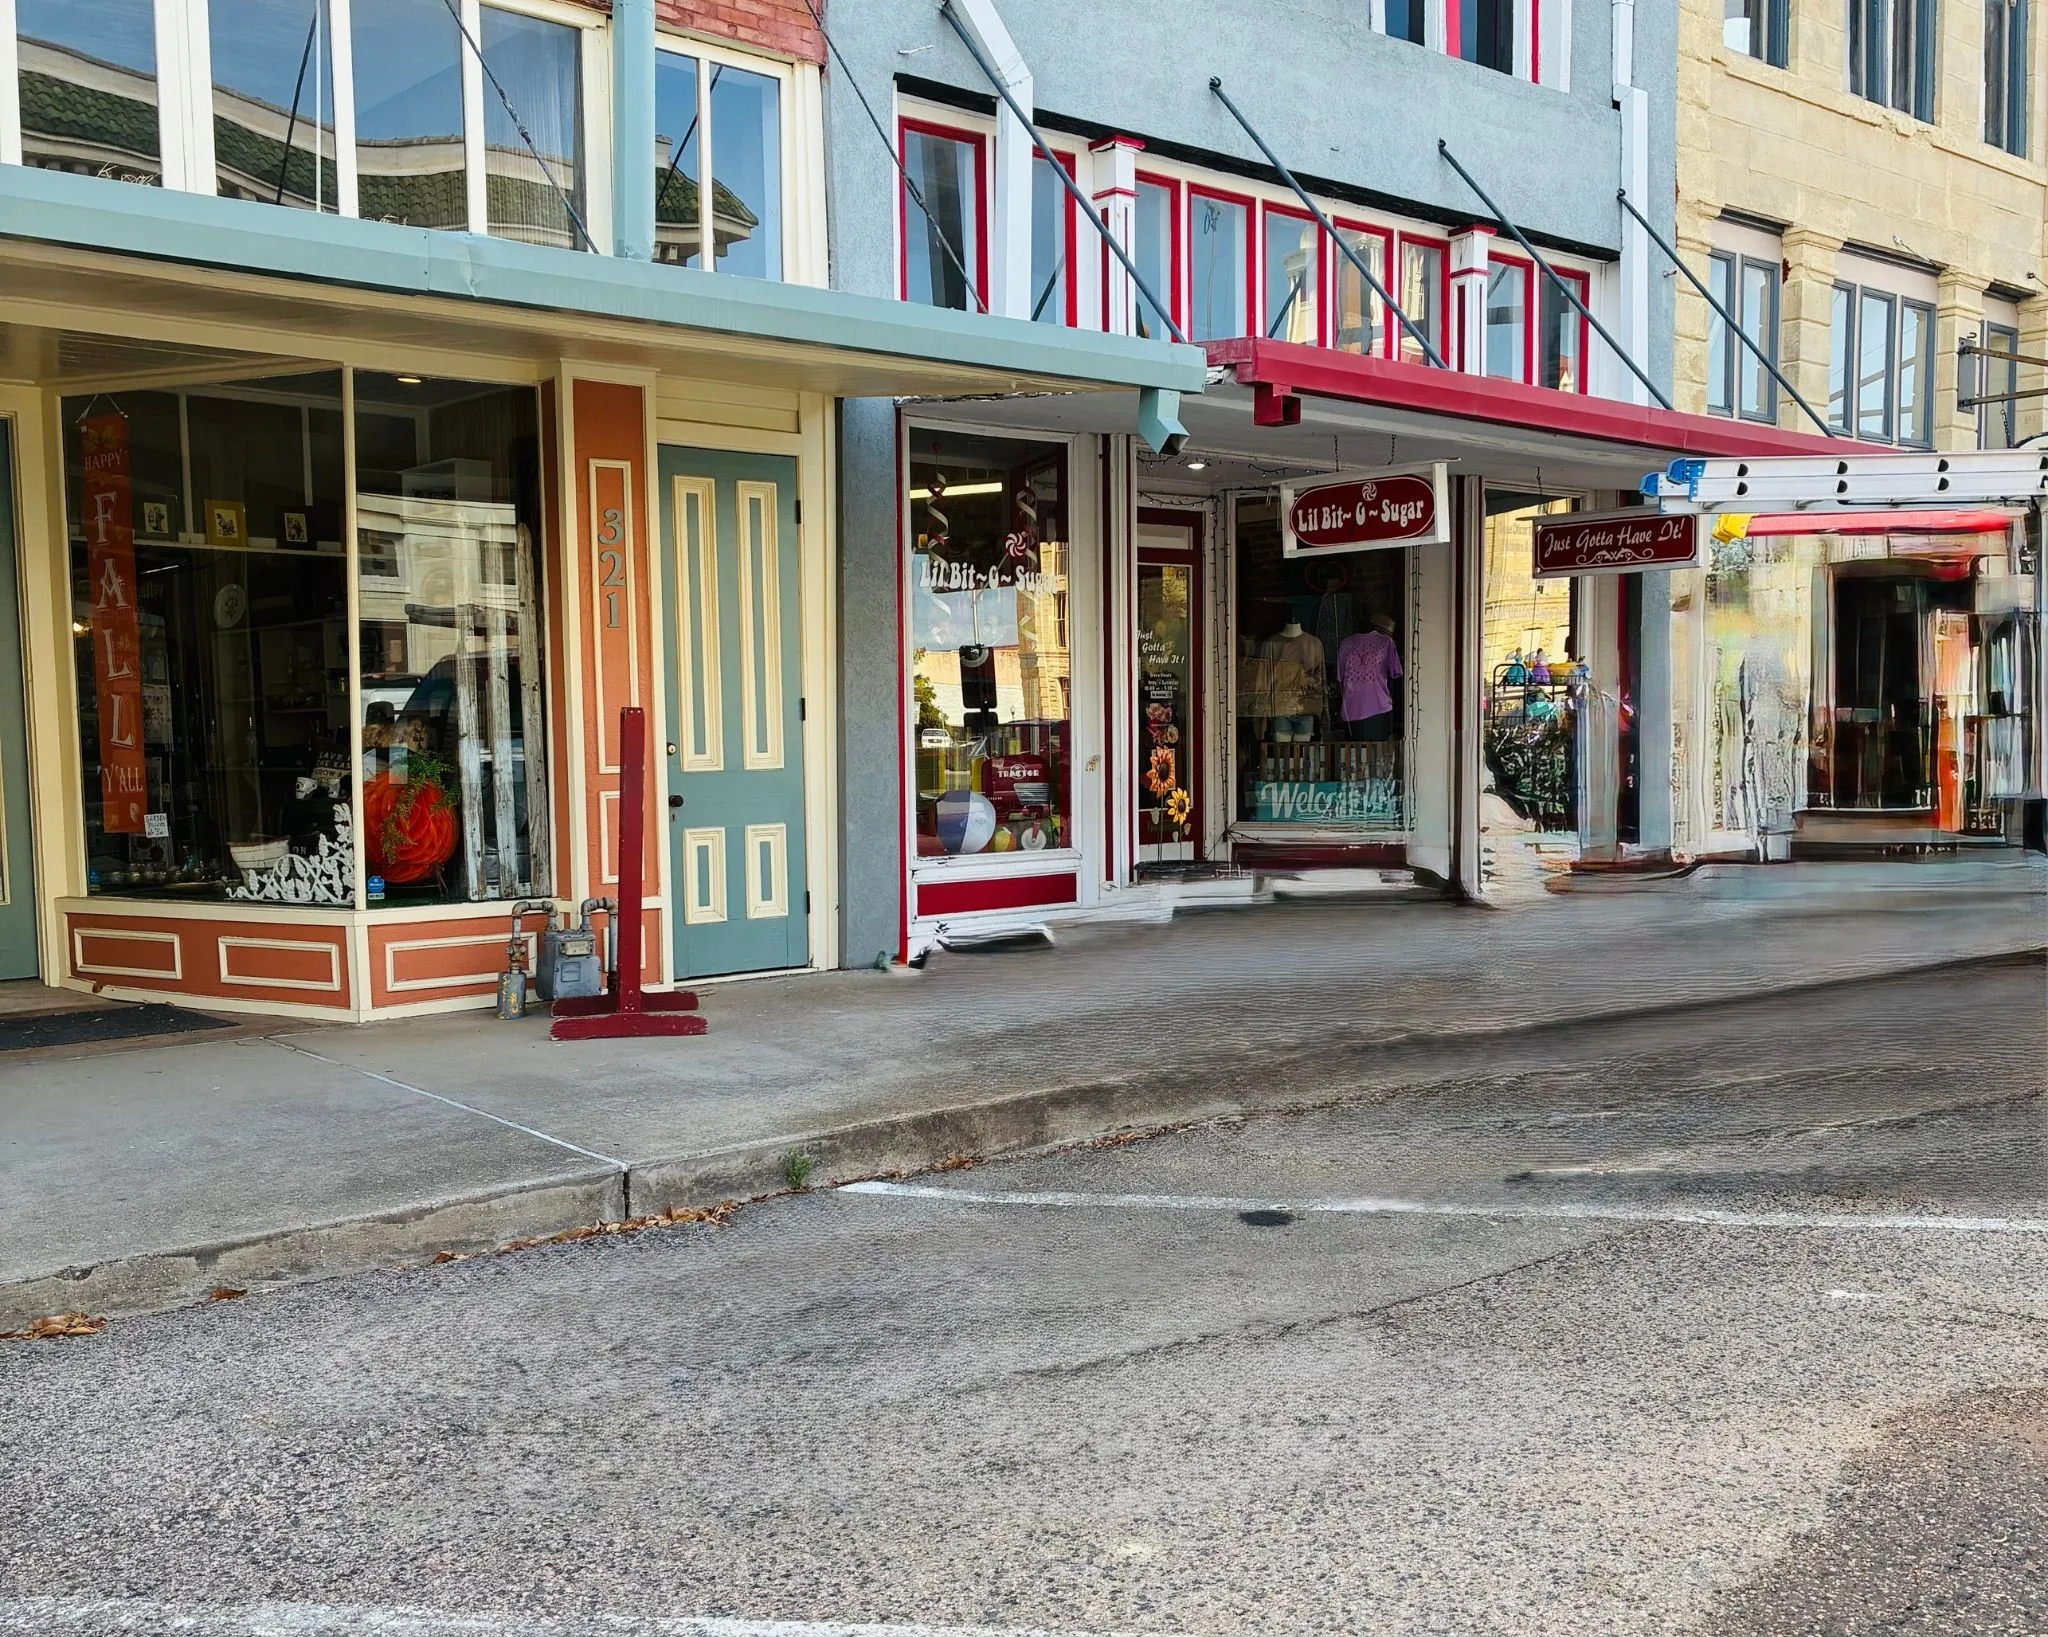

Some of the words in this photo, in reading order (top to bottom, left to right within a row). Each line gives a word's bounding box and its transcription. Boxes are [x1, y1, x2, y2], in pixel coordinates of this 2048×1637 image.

[84, 450, 123, 470] HAPPY
[1297, 508, 1319, 532] Lil
[1381, 499, 1424, 528] Sugar
[1544, 533, 1571, 558] Just
[1575, 529, 1613, 553] Gotta
[1617, 525, 1652, 547] Have
[1657, 517, 1686, 542] It!
[919, 561, 946, 587] Lil
[1015, 565, 1058, 595] Sugar
[1142, 642, 1165, 653] Gotta
[1149, 654, 1169, 664] Have
[319, 750, 345, 761] SAVE
[104, 763, 144, 793] Y'ALL
[997, 769, 1040, 779] TRACTOR
